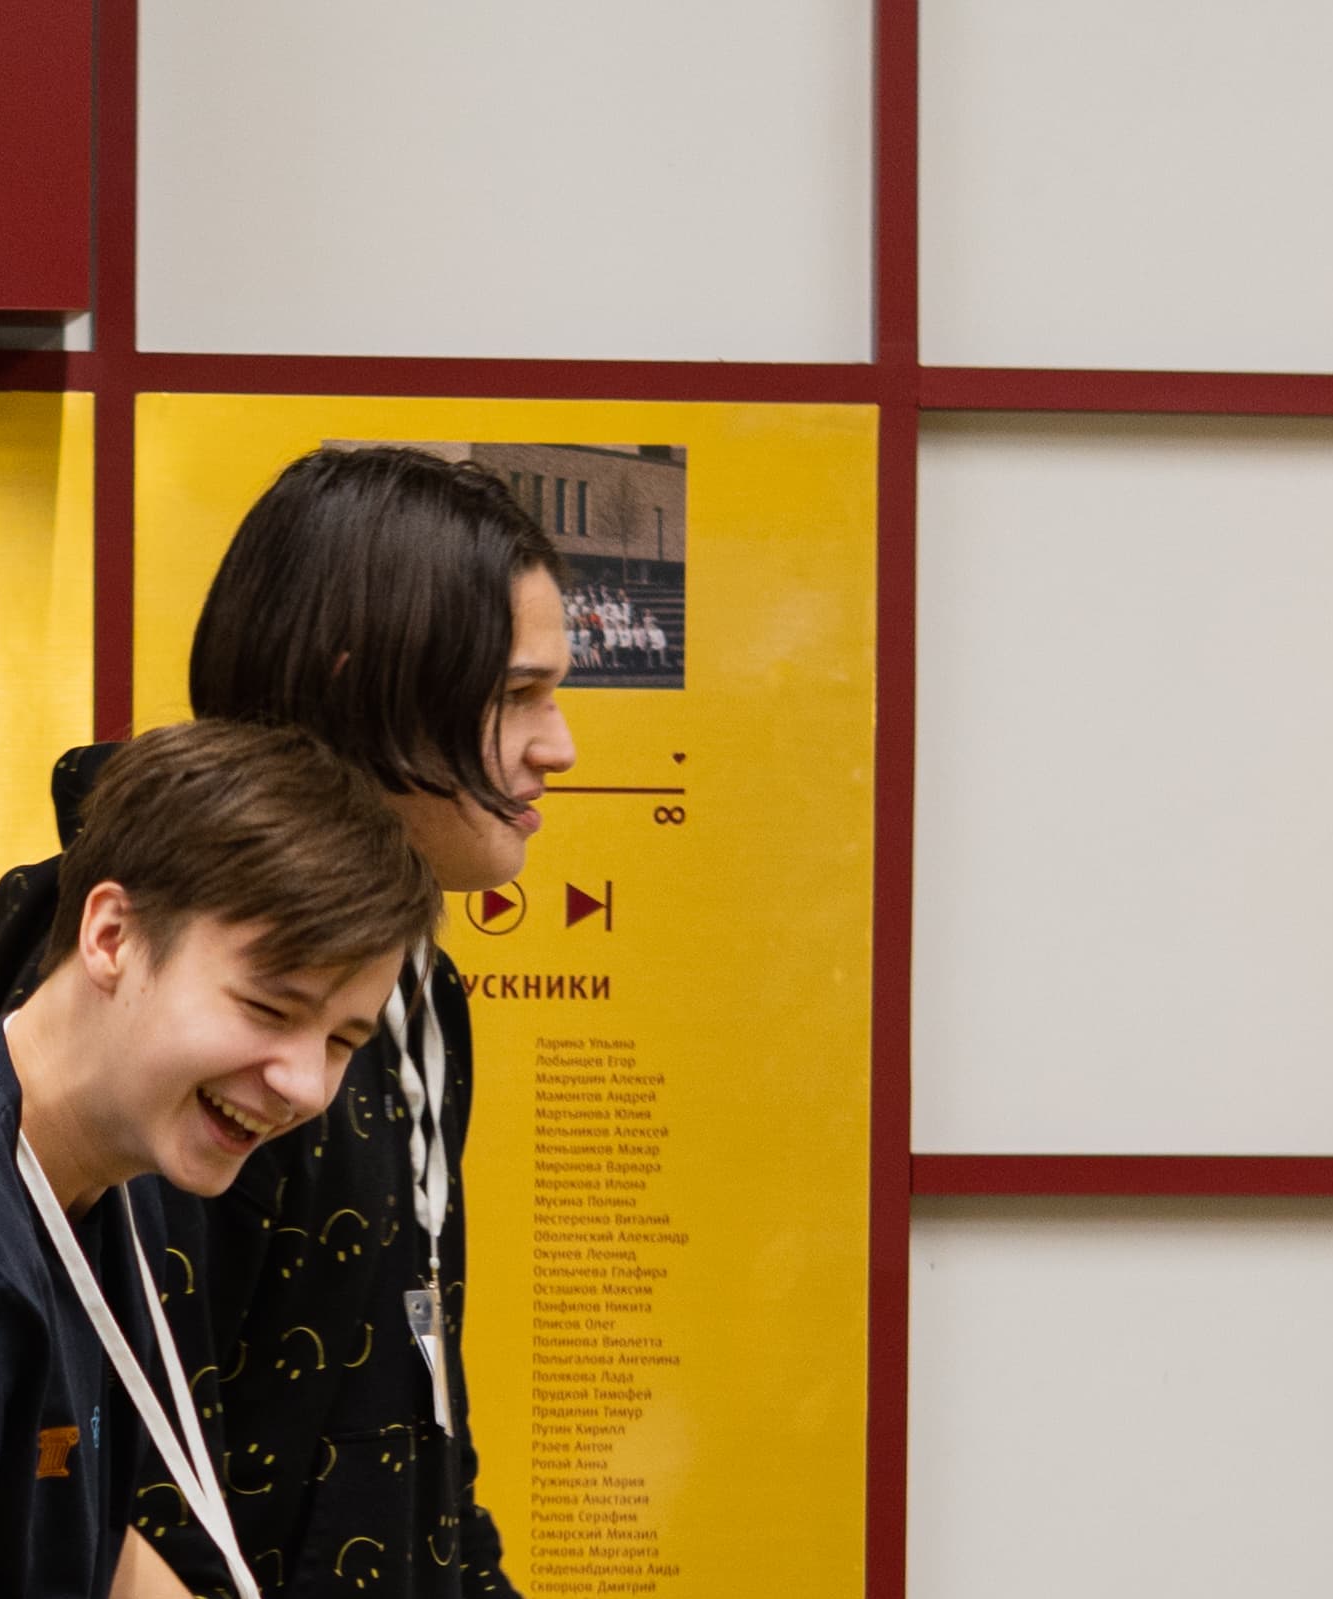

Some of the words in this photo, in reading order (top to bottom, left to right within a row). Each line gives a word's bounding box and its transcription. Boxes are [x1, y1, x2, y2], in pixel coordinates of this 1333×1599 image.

[461, 974, 611, 999] УСКНИКИ
[535, 1036, 586, 1053] Ларина
[588, 1037, 637, 1050] Ульяна
[606, 1054, 637, 1070] Егор
[534, 1071, 607, 1087] Макрушин
[609, 1072, 666, 1086] Алексей
[534, 1089, 603, 1103] Мамонтов
[606, 1090, 657, 1106] Андрей
[534, 1107, 612, 1122] Мартынова
[534, 1124, 611, 1138] Мельников
[613, 1125, 670, 1139] Алексей
[534, 1142, 614, 1156] Меньшиков
[617, 1143, 661, 1158] Макар
[534, 1159, 603, 1175] Миронова
[605, 1160, 663, 1176] Варвара
[533, 1194, 584, 1210] Мусина
[587, 1194, 637, 1208] Полина
[533, 1212, 611, 1227] Нестеренко
[614, 1213, 671, 1226] Виталий
[533, 1229, 615, 1243] Оболенский
[617, 1230, 690, 1246] Александр
[532, 1247, 583, 1263] Окунев
[586, 1247, 637, 1263] Леонид
[611, 1264, 668, 1281] Глафира
[532, 1282, 599, 1296] Осташков
[601, 1282, 654, 1296] Максим
[532, 1298, 602, 1315] Панфилов
[604, 1300, 653, 1314] Никита
[584, 1317, 616, 1331] Олег
[601, 1334, 663, 1349] Виолетта
[617, 1352, 681, 1367] Ангелина
[531, 1369, 597, 1384] Полякова
[600, 1369, 635, 1385] Лада
[593, 1387, 653, 1403] Тимофей
[603, 1405, 644, 1421] Тимур
[531, 1422, 573, 1437] Путин
[574, 1423, 626, 1438] Кирилл
[573, 1440, 614, 1453] Антон
[575, 1457, 609, 1471] Анна
[530, 1475, 599, 1490] Ружицкая
[601, 1475, 645, 1490] Мария
[530, 1492, 579, 1507] Рунова
[582, 1492, 650, 1506] Анастасия
[530, 1509, 575, 1523] Рылов
[577, 1509, 639, 1526] Серафим
[530, 1527, 603, 1543] Самарский
[606, 1527, 658, 1541] Михаил
[588, 1545, 660, 1561] Маргарита
[646, 1562, 681, 1578] Аида
[529, 1579, 594, 1595] Скворцов
[596, 1579, 658, 1596] Дмитрий
